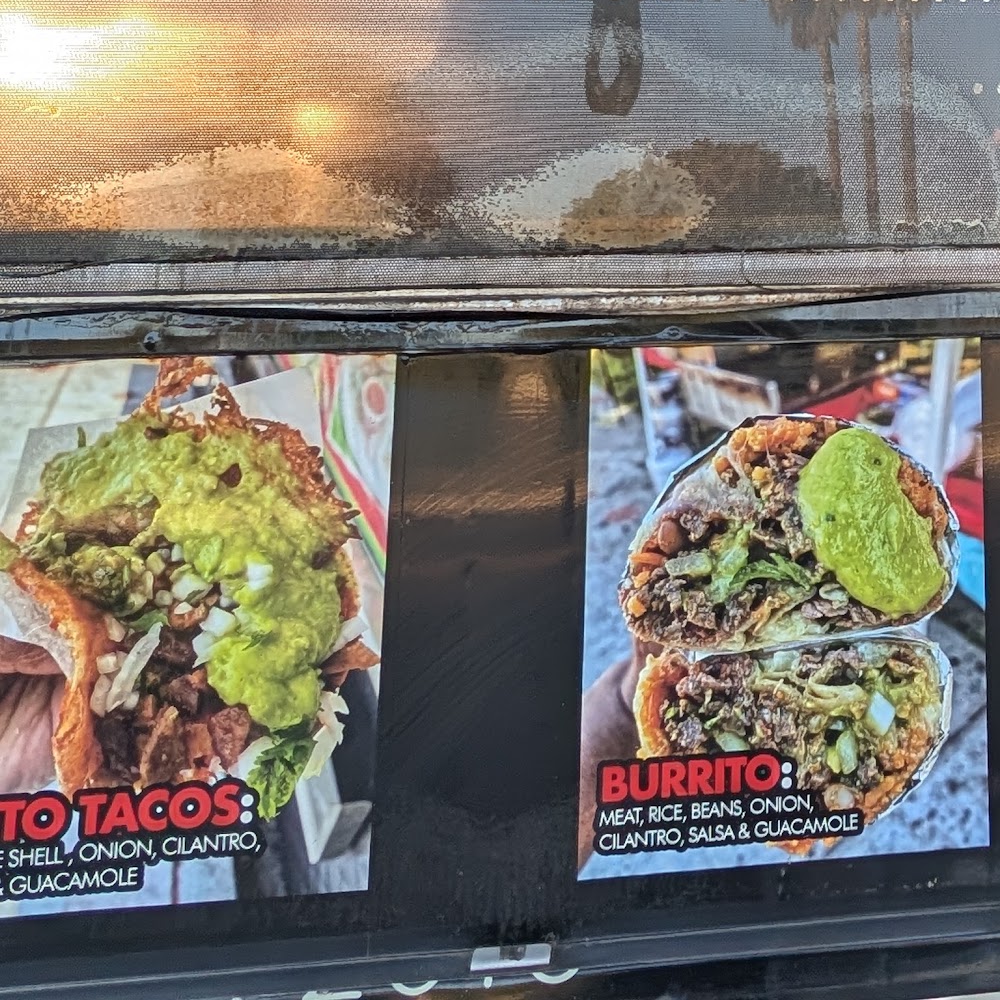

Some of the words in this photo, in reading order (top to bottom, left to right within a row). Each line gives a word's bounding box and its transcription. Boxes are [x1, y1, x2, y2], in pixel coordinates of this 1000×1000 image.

[602, 753, 793, 803] BURRITO:
[79, 783, 254, 836] TACOS:
[599, 806, 645, 828] MEAT,
[648, 804, 687, 824] RICE,
[690, 800, 747, 820] BEANS,
[750, 794, 815, 815] ONION,
[79, 838, 157, 863] ONION,
[162, 831, 261, 857] CILANTRO,
[599, 829, 685, 851] CILANTRO,
[688, 824, 734, 844] SALSA
[738, 823, 751, 840] &
[754, 813, 859, 838] GUACAMOLE
[9, 866, 138, 895] GUACAMOLE
